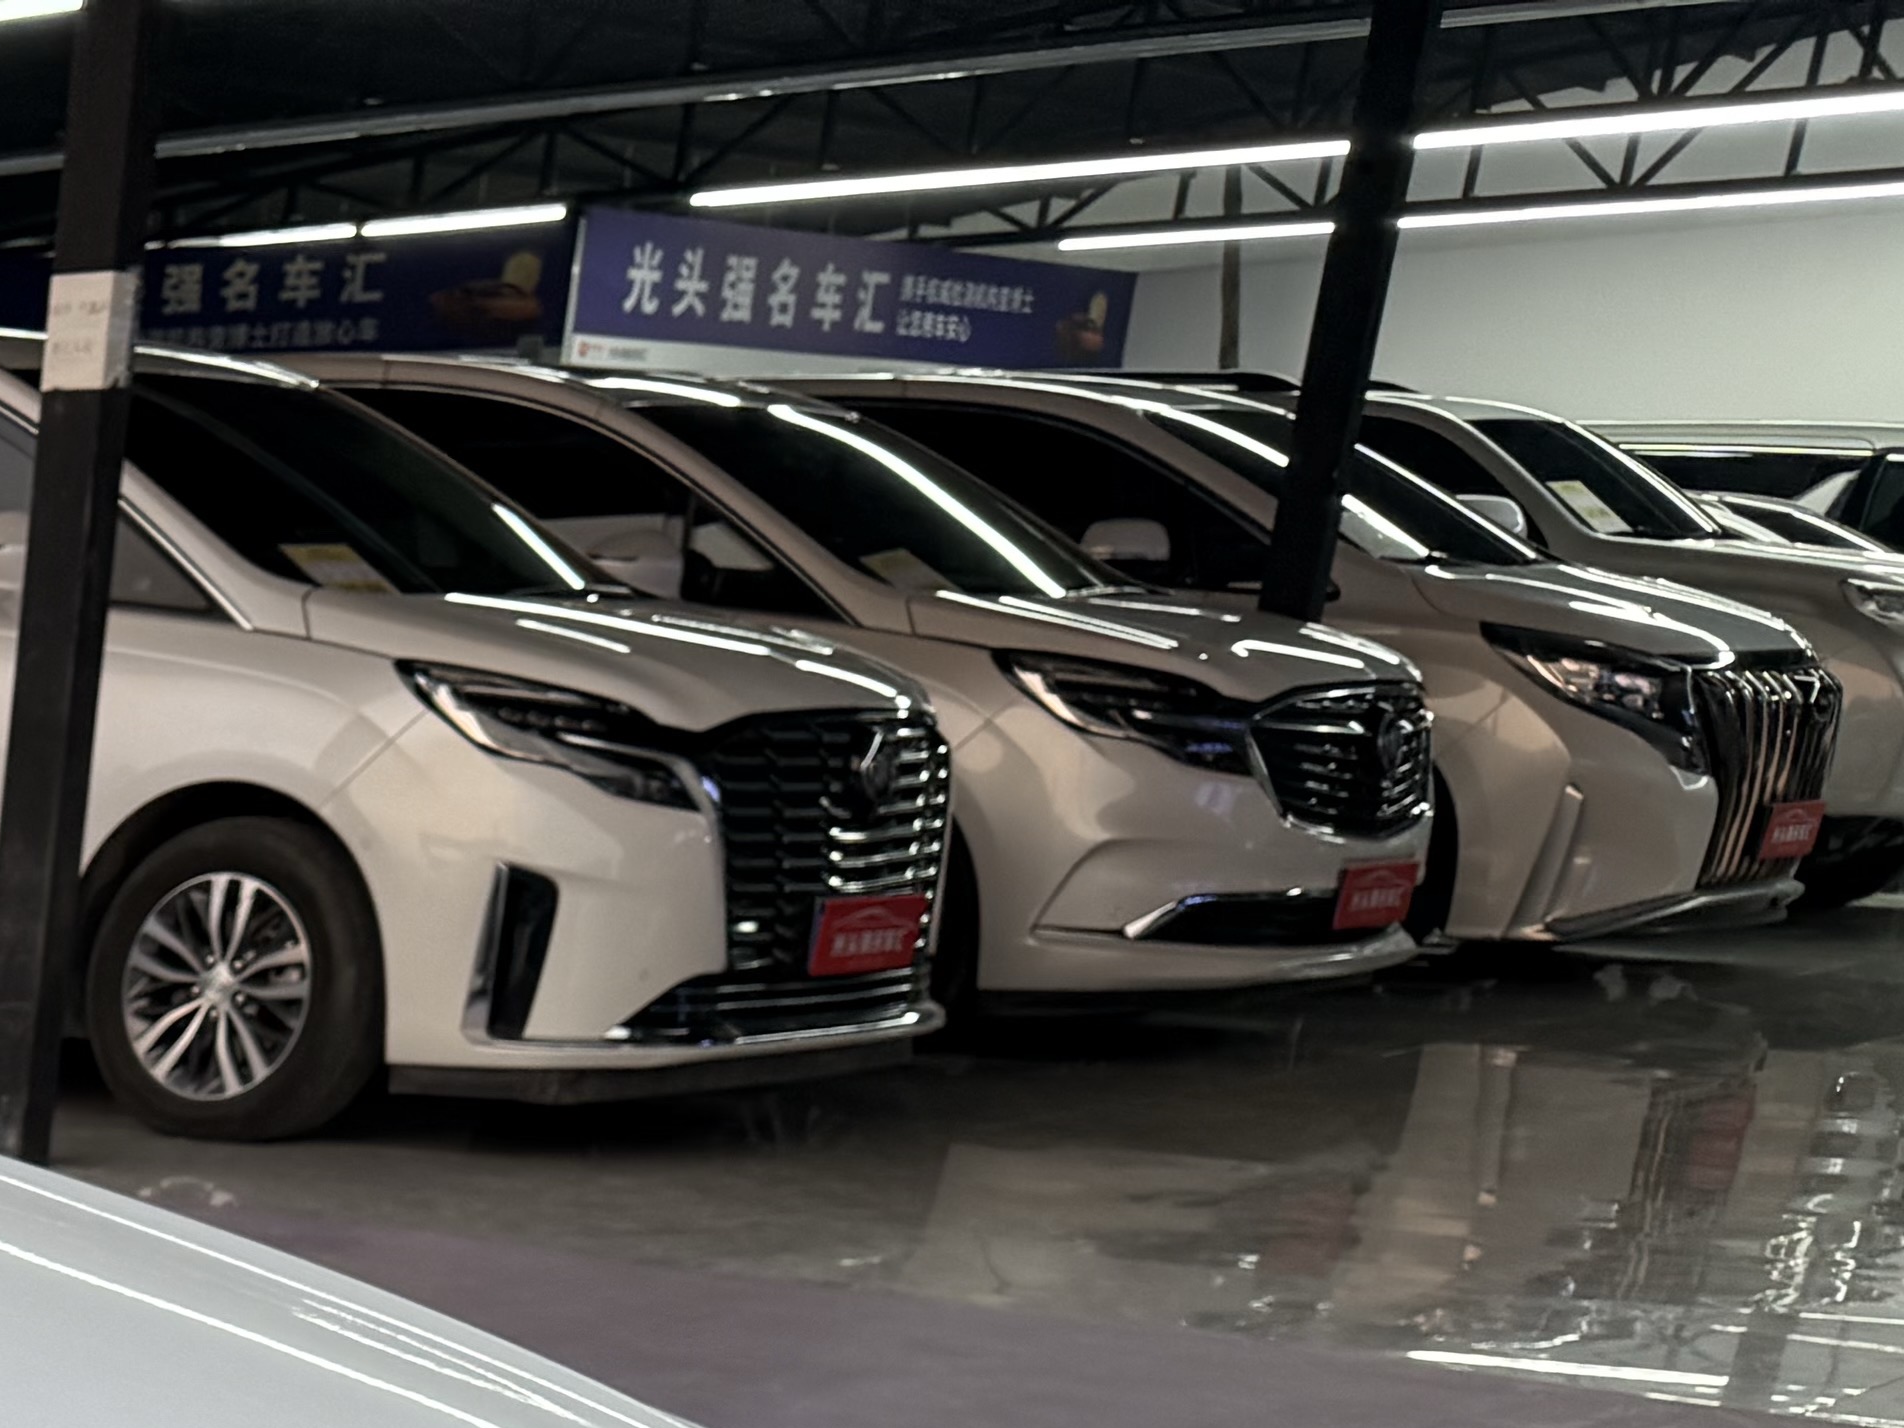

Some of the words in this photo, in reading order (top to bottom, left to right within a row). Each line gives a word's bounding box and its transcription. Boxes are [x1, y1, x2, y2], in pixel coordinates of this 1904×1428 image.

[161, 252, 388, 315] 强名车汇
[622, 240, 891, 333] 光头强名车汇
